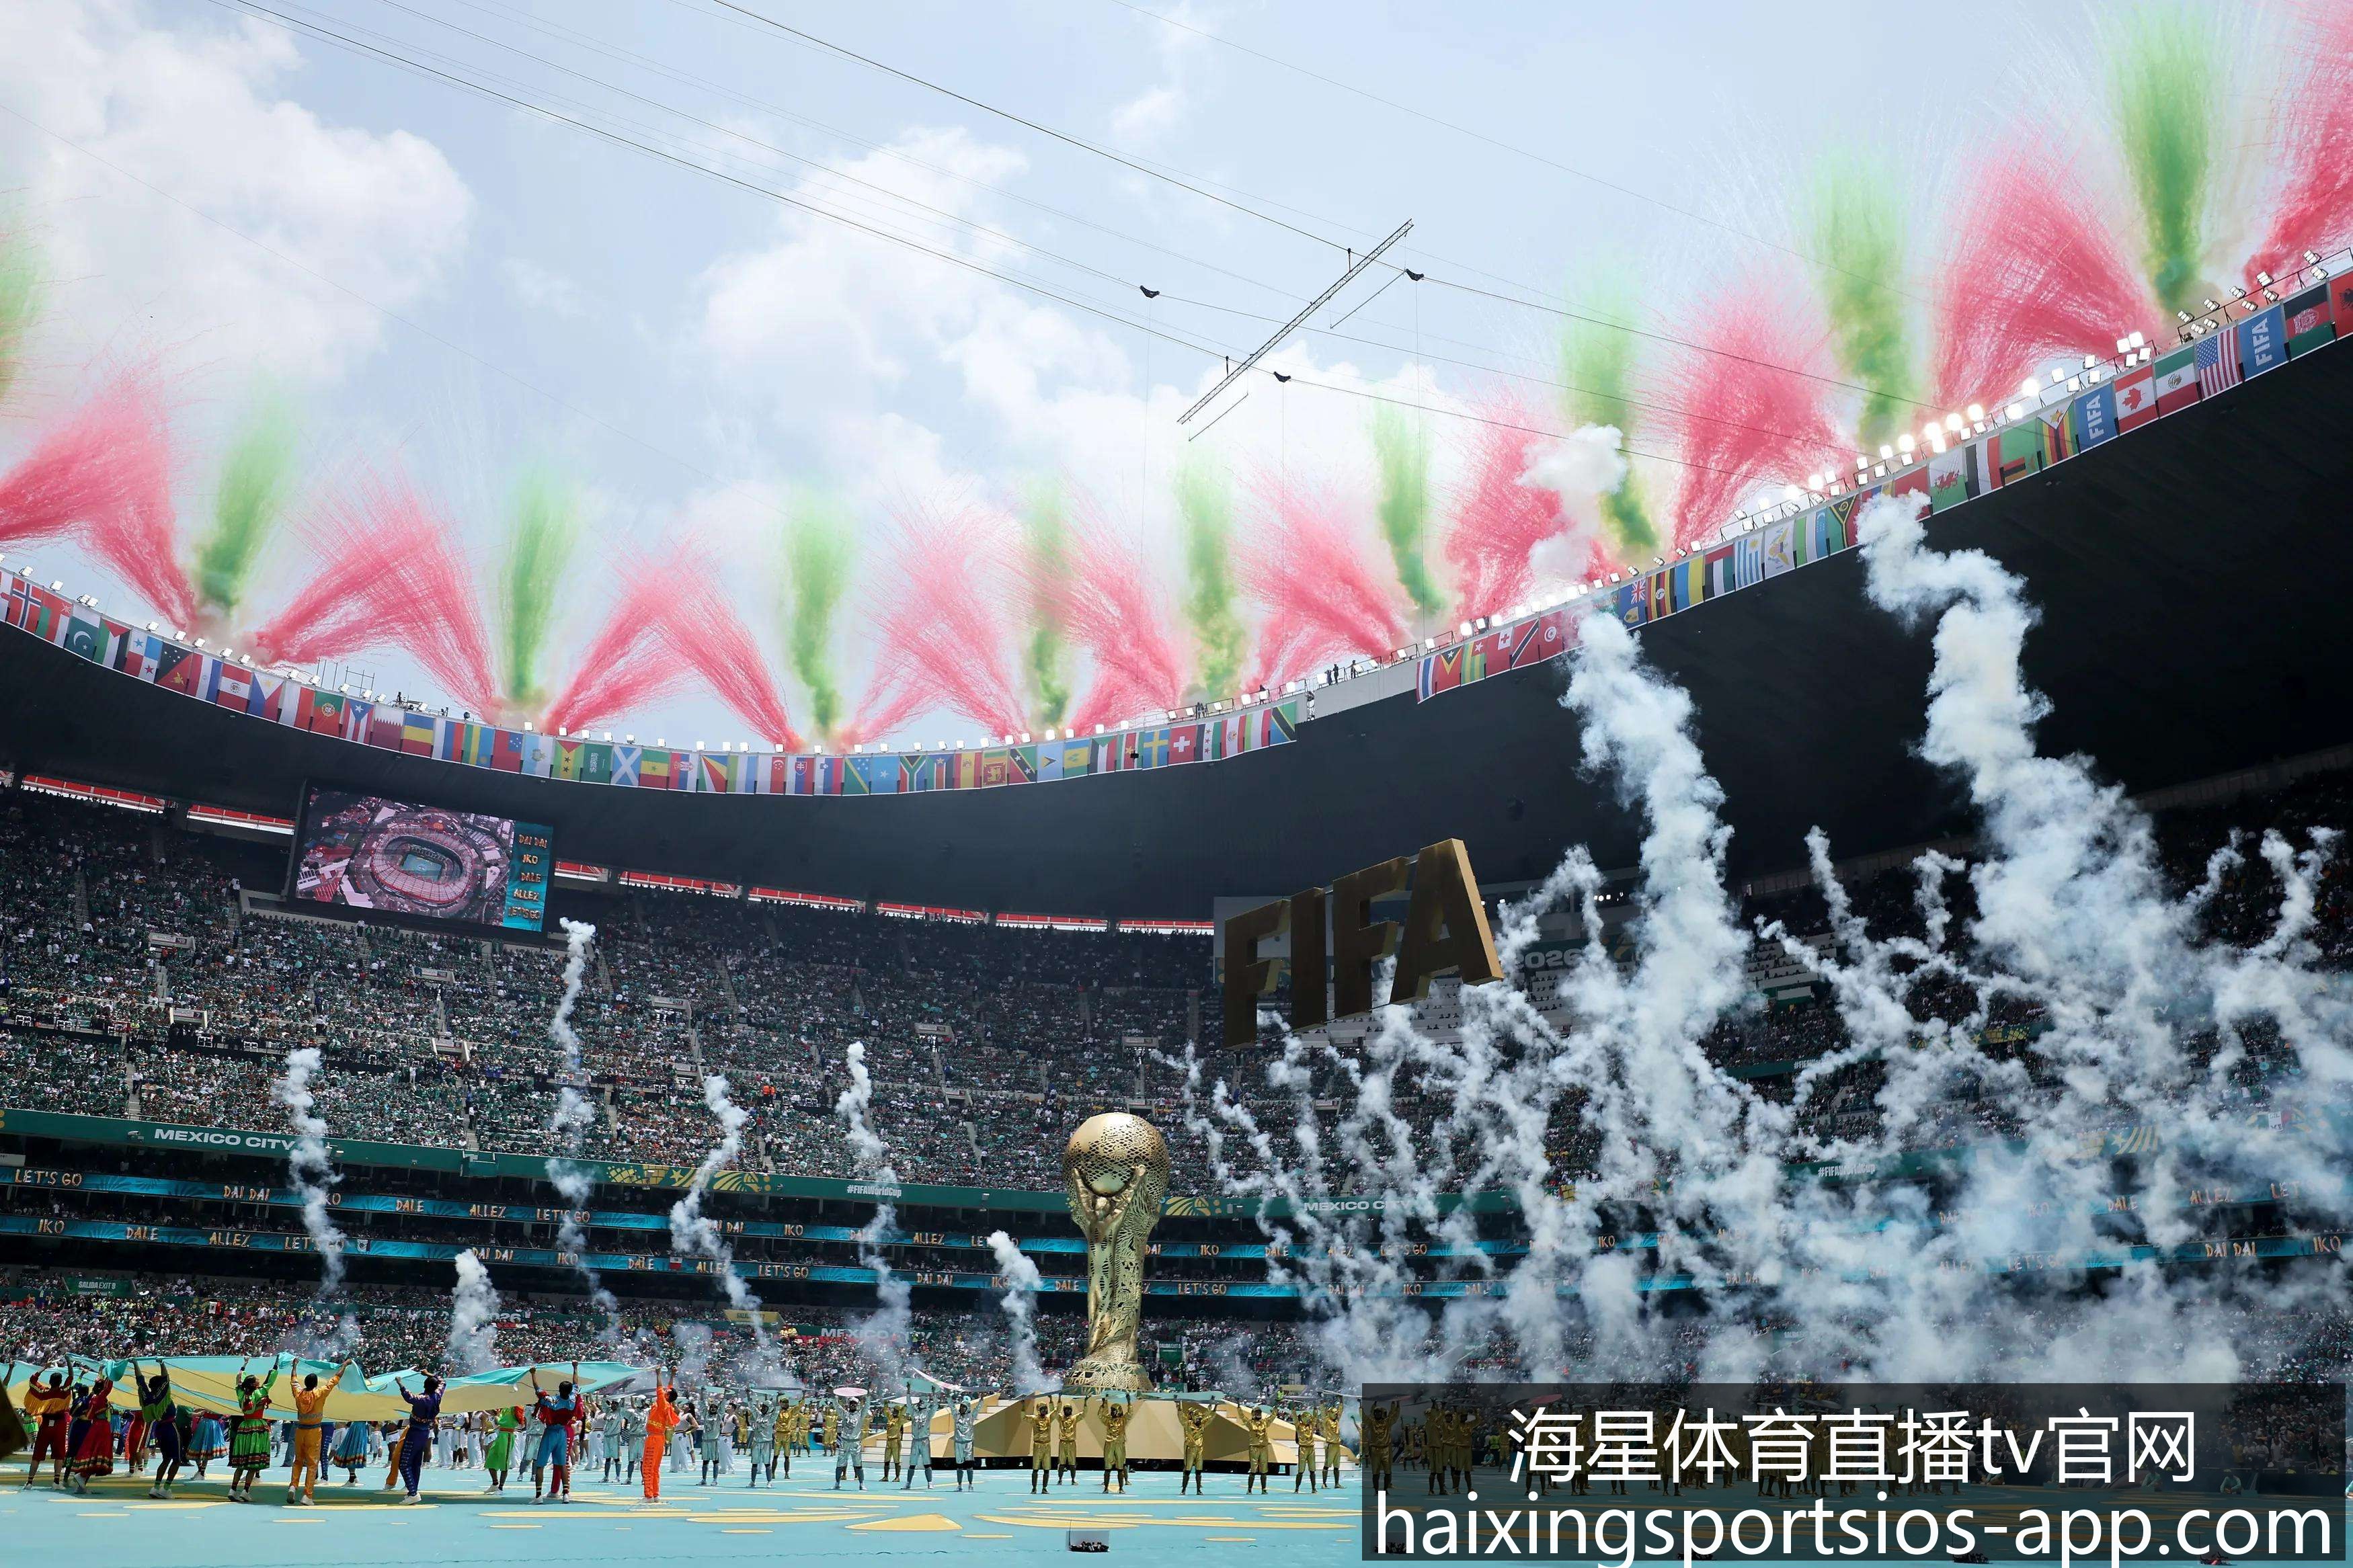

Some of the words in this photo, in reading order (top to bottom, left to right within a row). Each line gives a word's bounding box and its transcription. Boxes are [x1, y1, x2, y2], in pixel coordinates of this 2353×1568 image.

[2251, 317, 2273, 367] FIFA
[2086, 393, 2104, 440] FIFA
[522, 854, 539, 864] IKO
[520, 872, 541, 882] DALE
[514, 888, 539, 901] ALLEZ
[1224, 837, 1505, 1050] FIFA
[154, 1128, 241, 1145] MEXICO
[245, 1137, 296, 1151] CITY
[15, 1169, 58, 1186] LET'S
[62, 1173, 82, 1187] GO
[223, 1186, 245, 1198] DAI
[249, 1188, 270, 1201] DAI
[846, 1184, 902, 1198] #FIFAWorldCup
[2190, 1187, 2234, 1205] ALLEZ
[325, 1193, 342, 1206] KO
[395, 1199, 424, 1212] DALE
[1304, 1200, 1370, 1211] MEXICO
[2108, 1194, 2139, 1211] DALE
[469, 1204, 506, 1219] ALLEZ
[575, 1211, 590, 1223] GO
[38, 1219, 65, 1235] IKO
[727, 1222, 744, 1233] DAI
[784, 1224, 803, 1237] IKO
[126, 1227, 159, 1241] DALE
[209, 1231, 251, 1247] ALLEZ
[913, 1232, 945, 1245] ALLEZ
[1599, 1235, 1616, 1248] IKO
[2313, 1235, 2342, 1253] IKO
[473, 1247, 490, 1260] DAI
[495, 1249, 514, 1262] DAI
[1145, 1244, 1161, 1255] DAI
[1201, 1244, 1220, 1255] IKO
[1265, 1246, 1289, 1257] DALE
[1413, 1243, 1427, 1255] GO
[2205, 1242, 2227, 1257] DAI
[2233, 1241, 2257, 1257] DAI
[557, 1252, 579, 1266] IKO
[628, 1257, 654, 1270] DALE
[758, 1264, 791, 1278] LET'S
[793, 1266, 809, 1279] GO
[78, 1281, 98, 1289] SALIDA
[917, 1272, 932, 1284] DAI
[936, 1274, 953, 1286] DAI
[1055, 1280, 1079, 1292] DALE
[1179, 1282, 1208, 1294] LET'S
[1212, 1284, 1227, 1295] GO
[1404, 1284, 1421, 1296] IKO
[489, 1313, 522, 1324] 026
